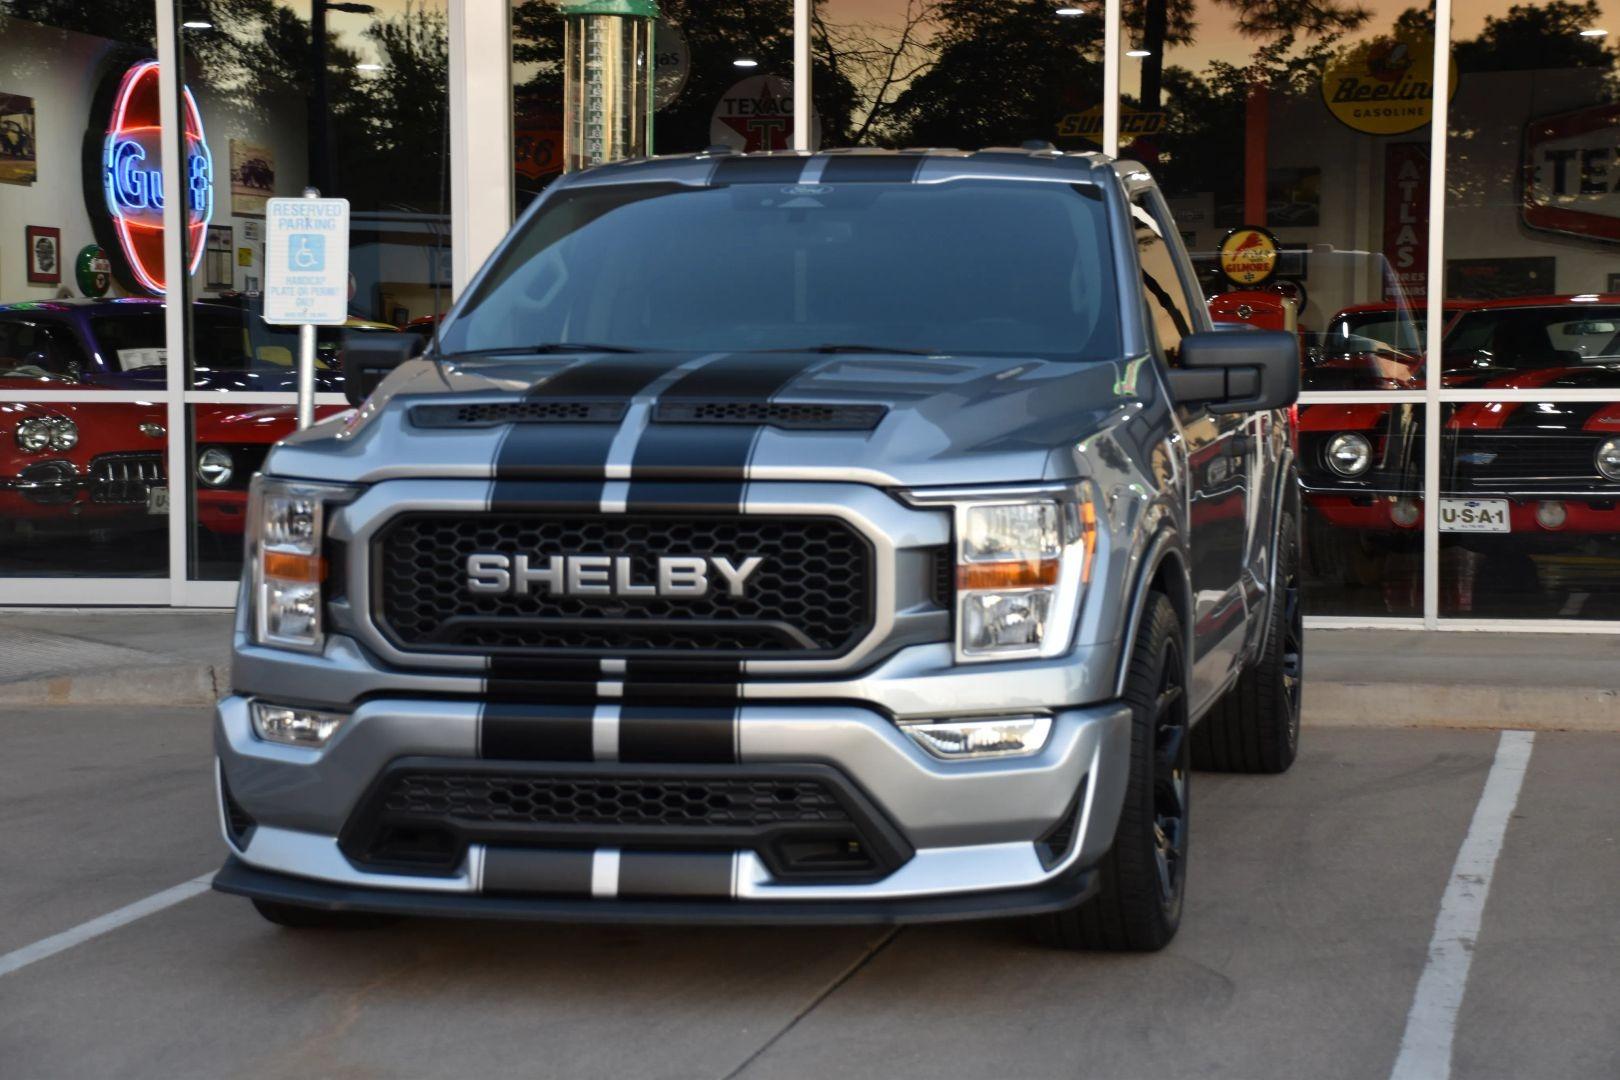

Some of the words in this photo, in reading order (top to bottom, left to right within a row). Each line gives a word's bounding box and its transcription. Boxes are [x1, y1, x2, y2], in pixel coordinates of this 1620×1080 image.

[1331, 75, 1433, 103] Beelin
[723, 98, 795, 115] TEXAC
[1353, 106, 1425, 118] GASOLINE
[114, 141, 208, 211] Guf
[1543, 148, 1620, 195] TE
[273, 203, 341, 217] RESERVED
[1396, 160, 1420, 268] ATLAS
[278, 218, 336, 230] PARKING
[1226, 263, 1270, 272] GILMORE
[466, 553, 764, 597] SHELBY
